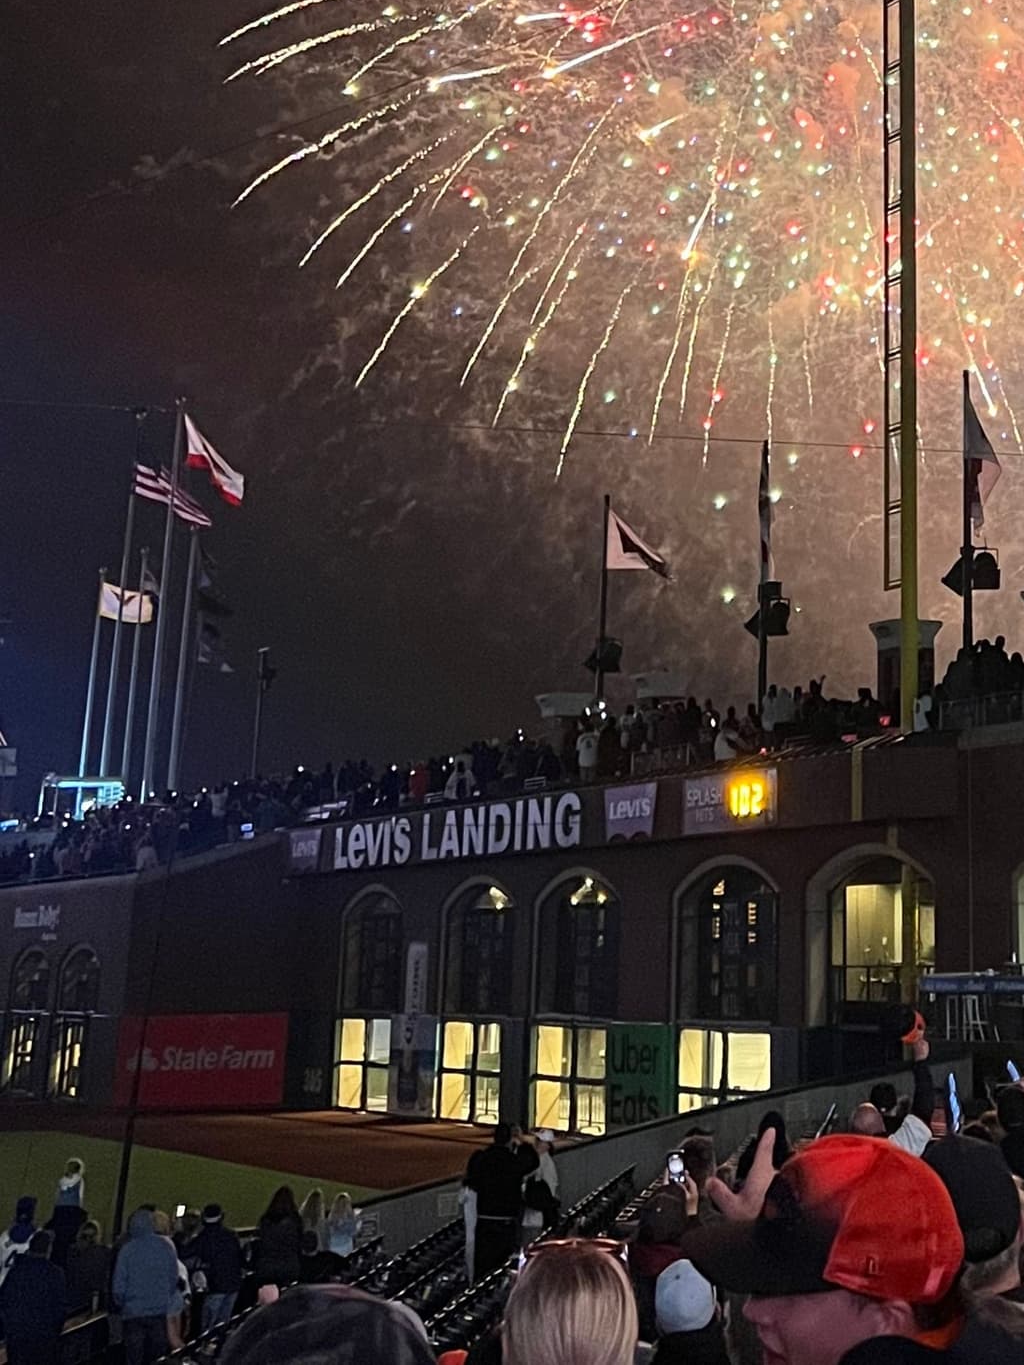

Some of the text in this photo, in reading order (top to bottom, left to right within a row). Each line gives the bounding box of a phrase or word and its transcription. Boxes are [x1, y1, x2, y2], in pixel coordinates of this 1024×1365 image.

[687, 787, 722, 808] SPLASH
[730, 782, 764, 817] 102
[421, 792, 581, 860] LANDING
[611, 1033, 660, 1074] Uber
[610, 1084, 659, 1125] Eats
